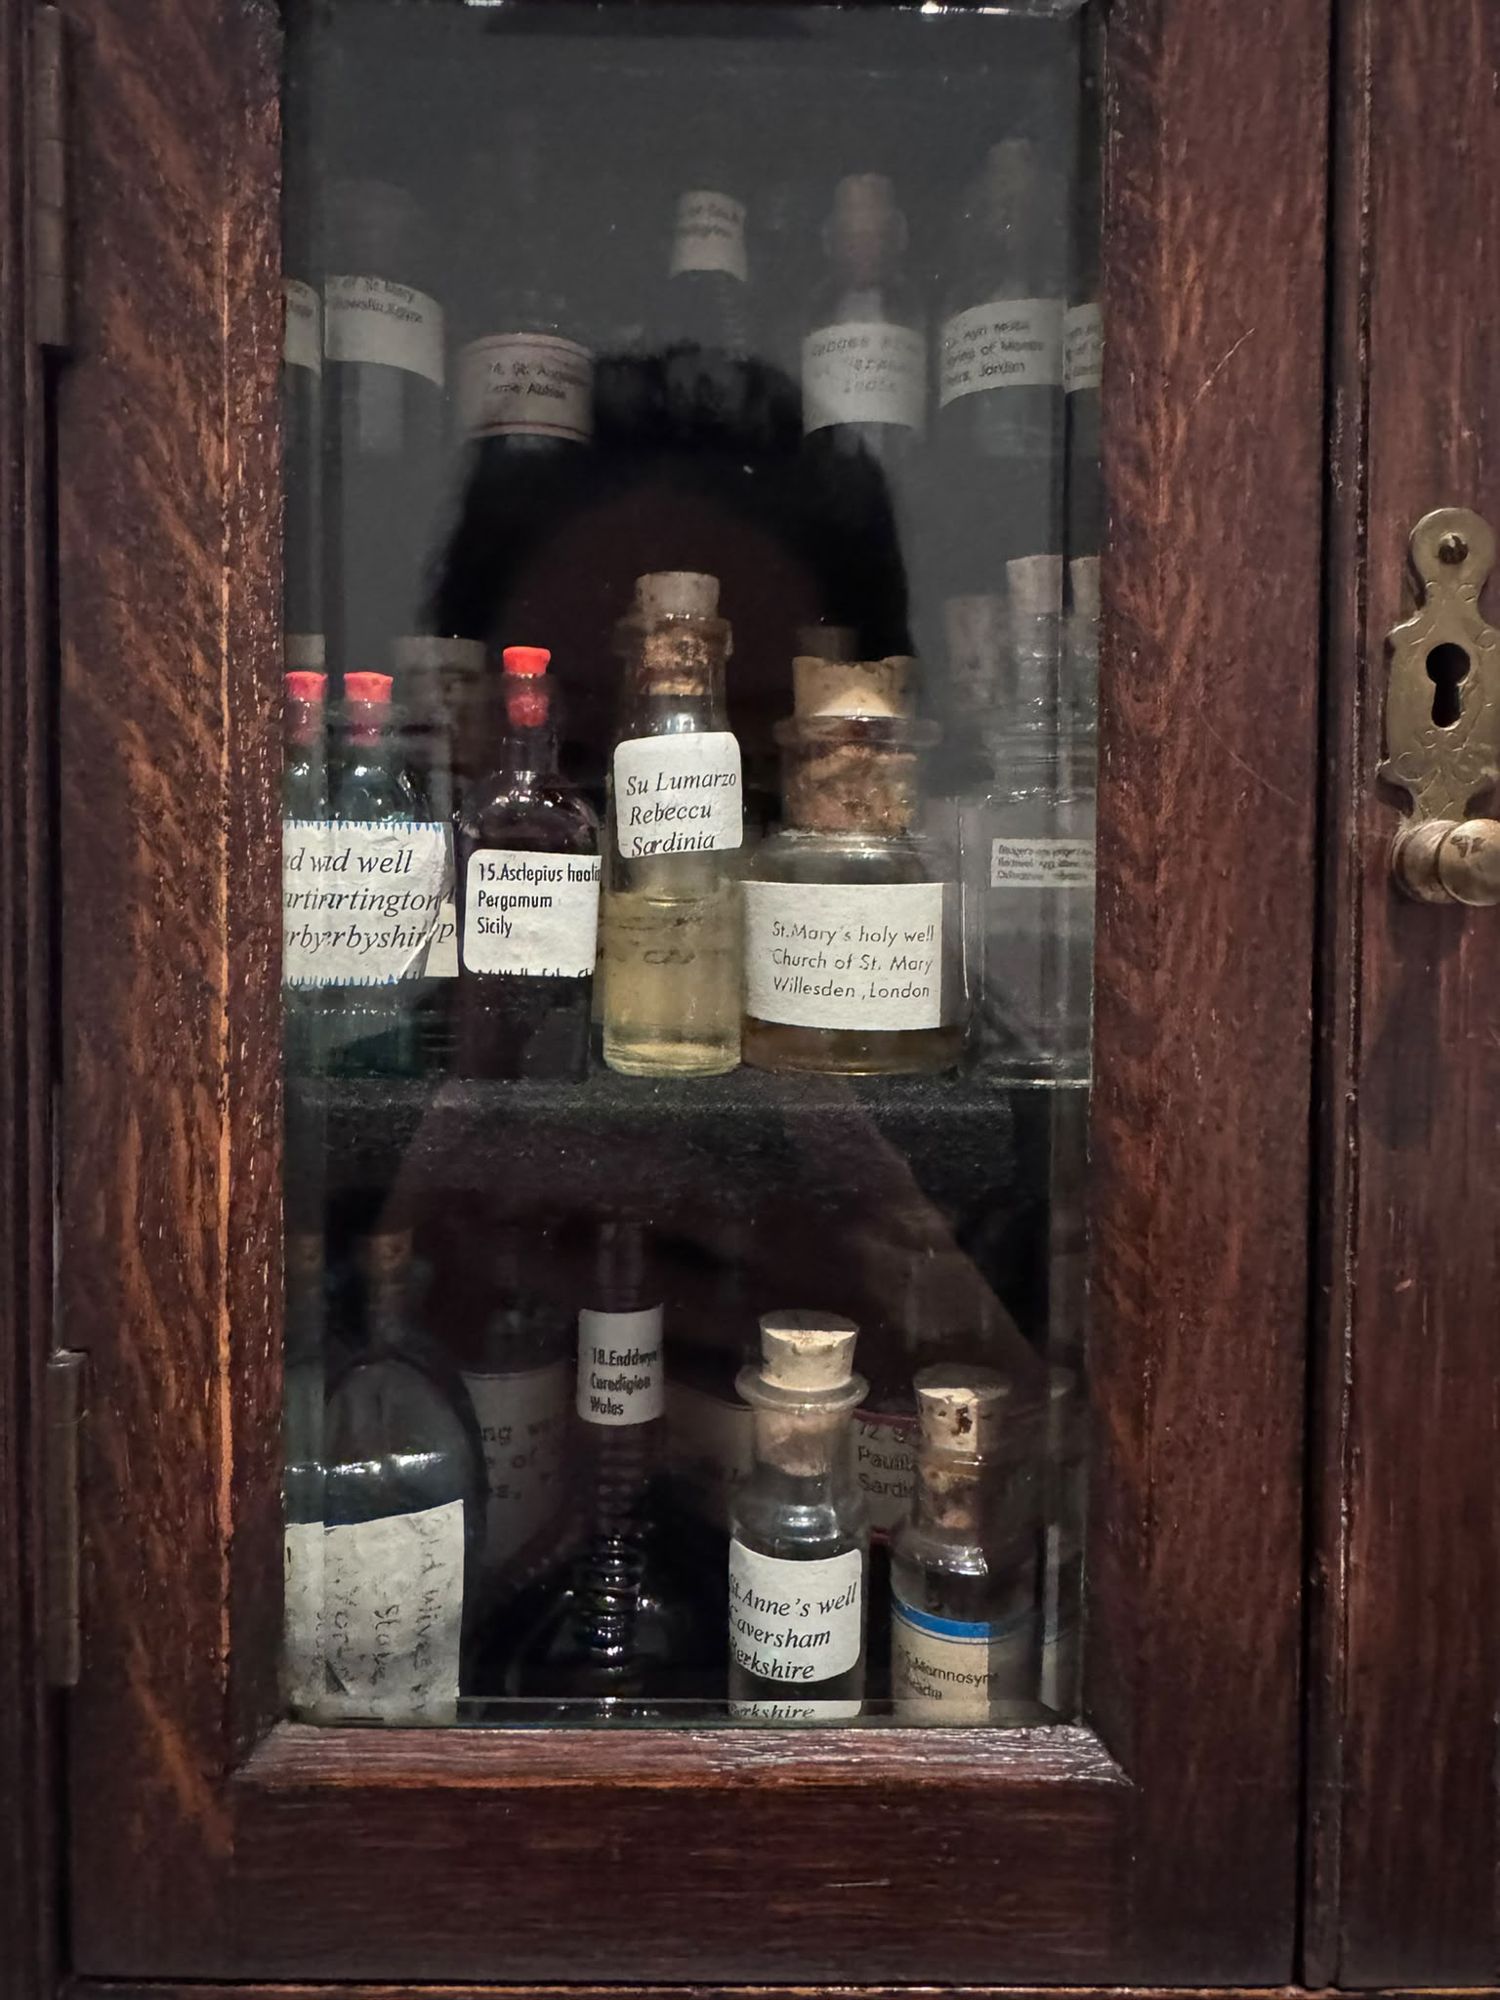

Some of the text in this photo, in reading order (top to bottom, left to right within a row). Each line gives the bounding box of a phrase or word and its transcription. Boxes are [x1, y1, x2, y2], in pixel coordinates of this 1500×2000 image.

[626, 771, 737, 796] Su Lumarzo
[629, 802, 712, 826] Rebeccu
[631, 832, 715, 857] Sardinia
[357, 849, 413, 874] well
[479, 862, 563, 885] 15.Asclepius
[477, 890, 553, 912] Pergamum
[477, 915, 513, 938] Sicily
[858, 926, 898, 947] holy
[904, 925, 934, 943] well
[772, 949, 827, 969] Church
[835, 953, 852, 970] of
[890, 957, 934, 975] Mary
[773, 977, 856, 998] Willesden
[817, 1581, 857, 1615] well
